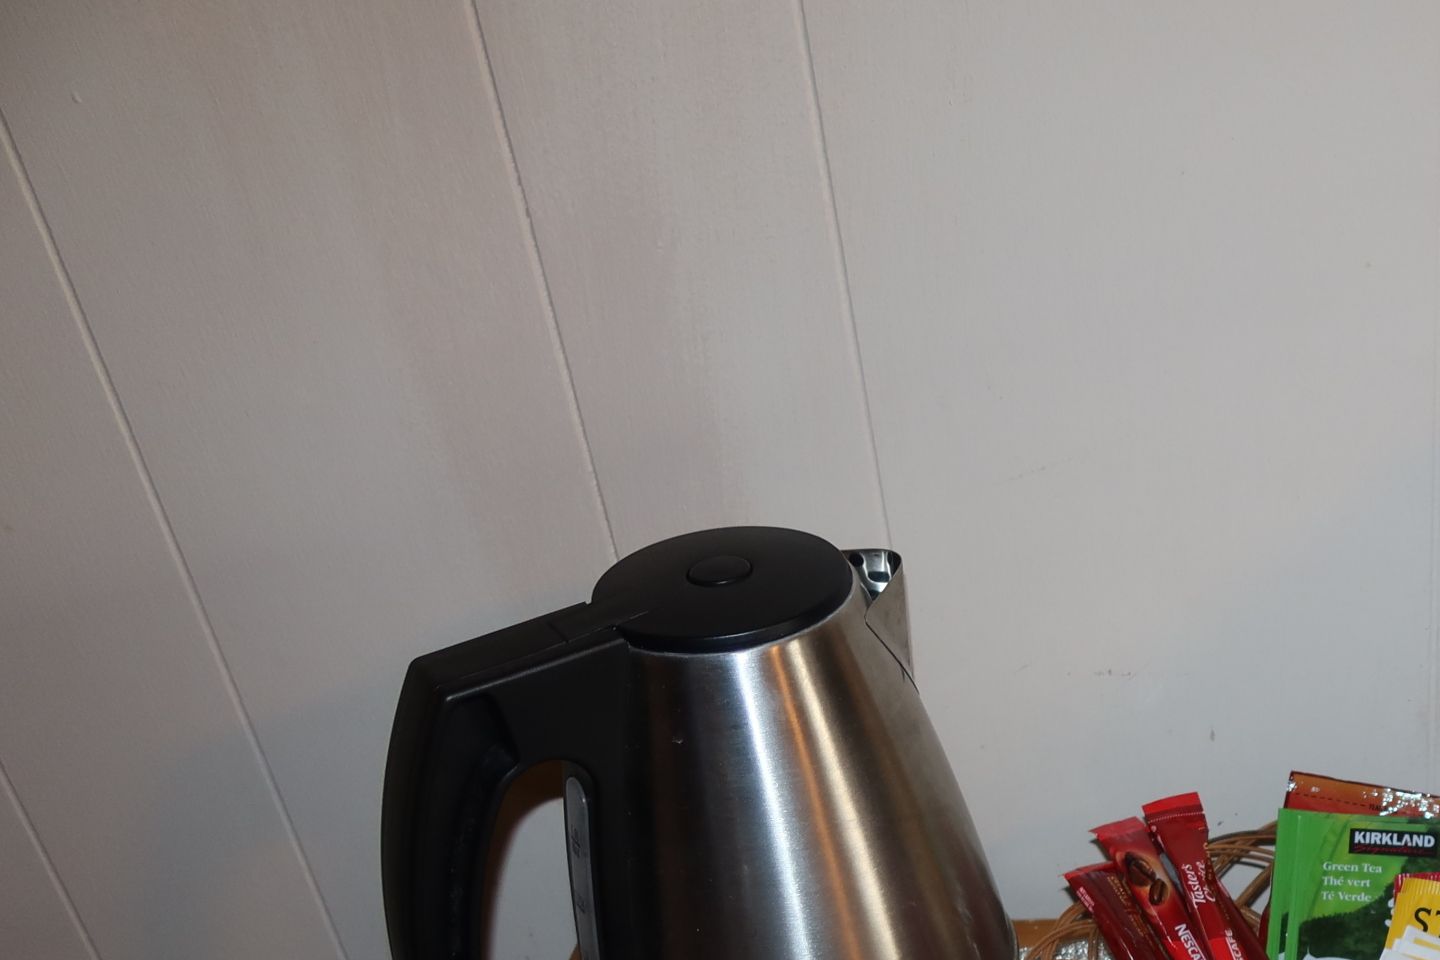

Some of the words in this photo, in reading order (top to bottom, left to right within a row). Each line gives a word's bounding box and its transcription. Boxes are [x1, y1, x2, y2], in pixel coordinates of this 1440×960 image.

[1354, 830, 1436, 848] KIRKLAND
[1323, 861, 1358, 873] Green
[1363, 862, 1382, 873] Tea
[1322, 875, 1344, 886] Thé
[1347, 877, 1370, 887] vert
[1321, 890, 1335, 900] Té
[1338, 890, 1371, 902] Verde
